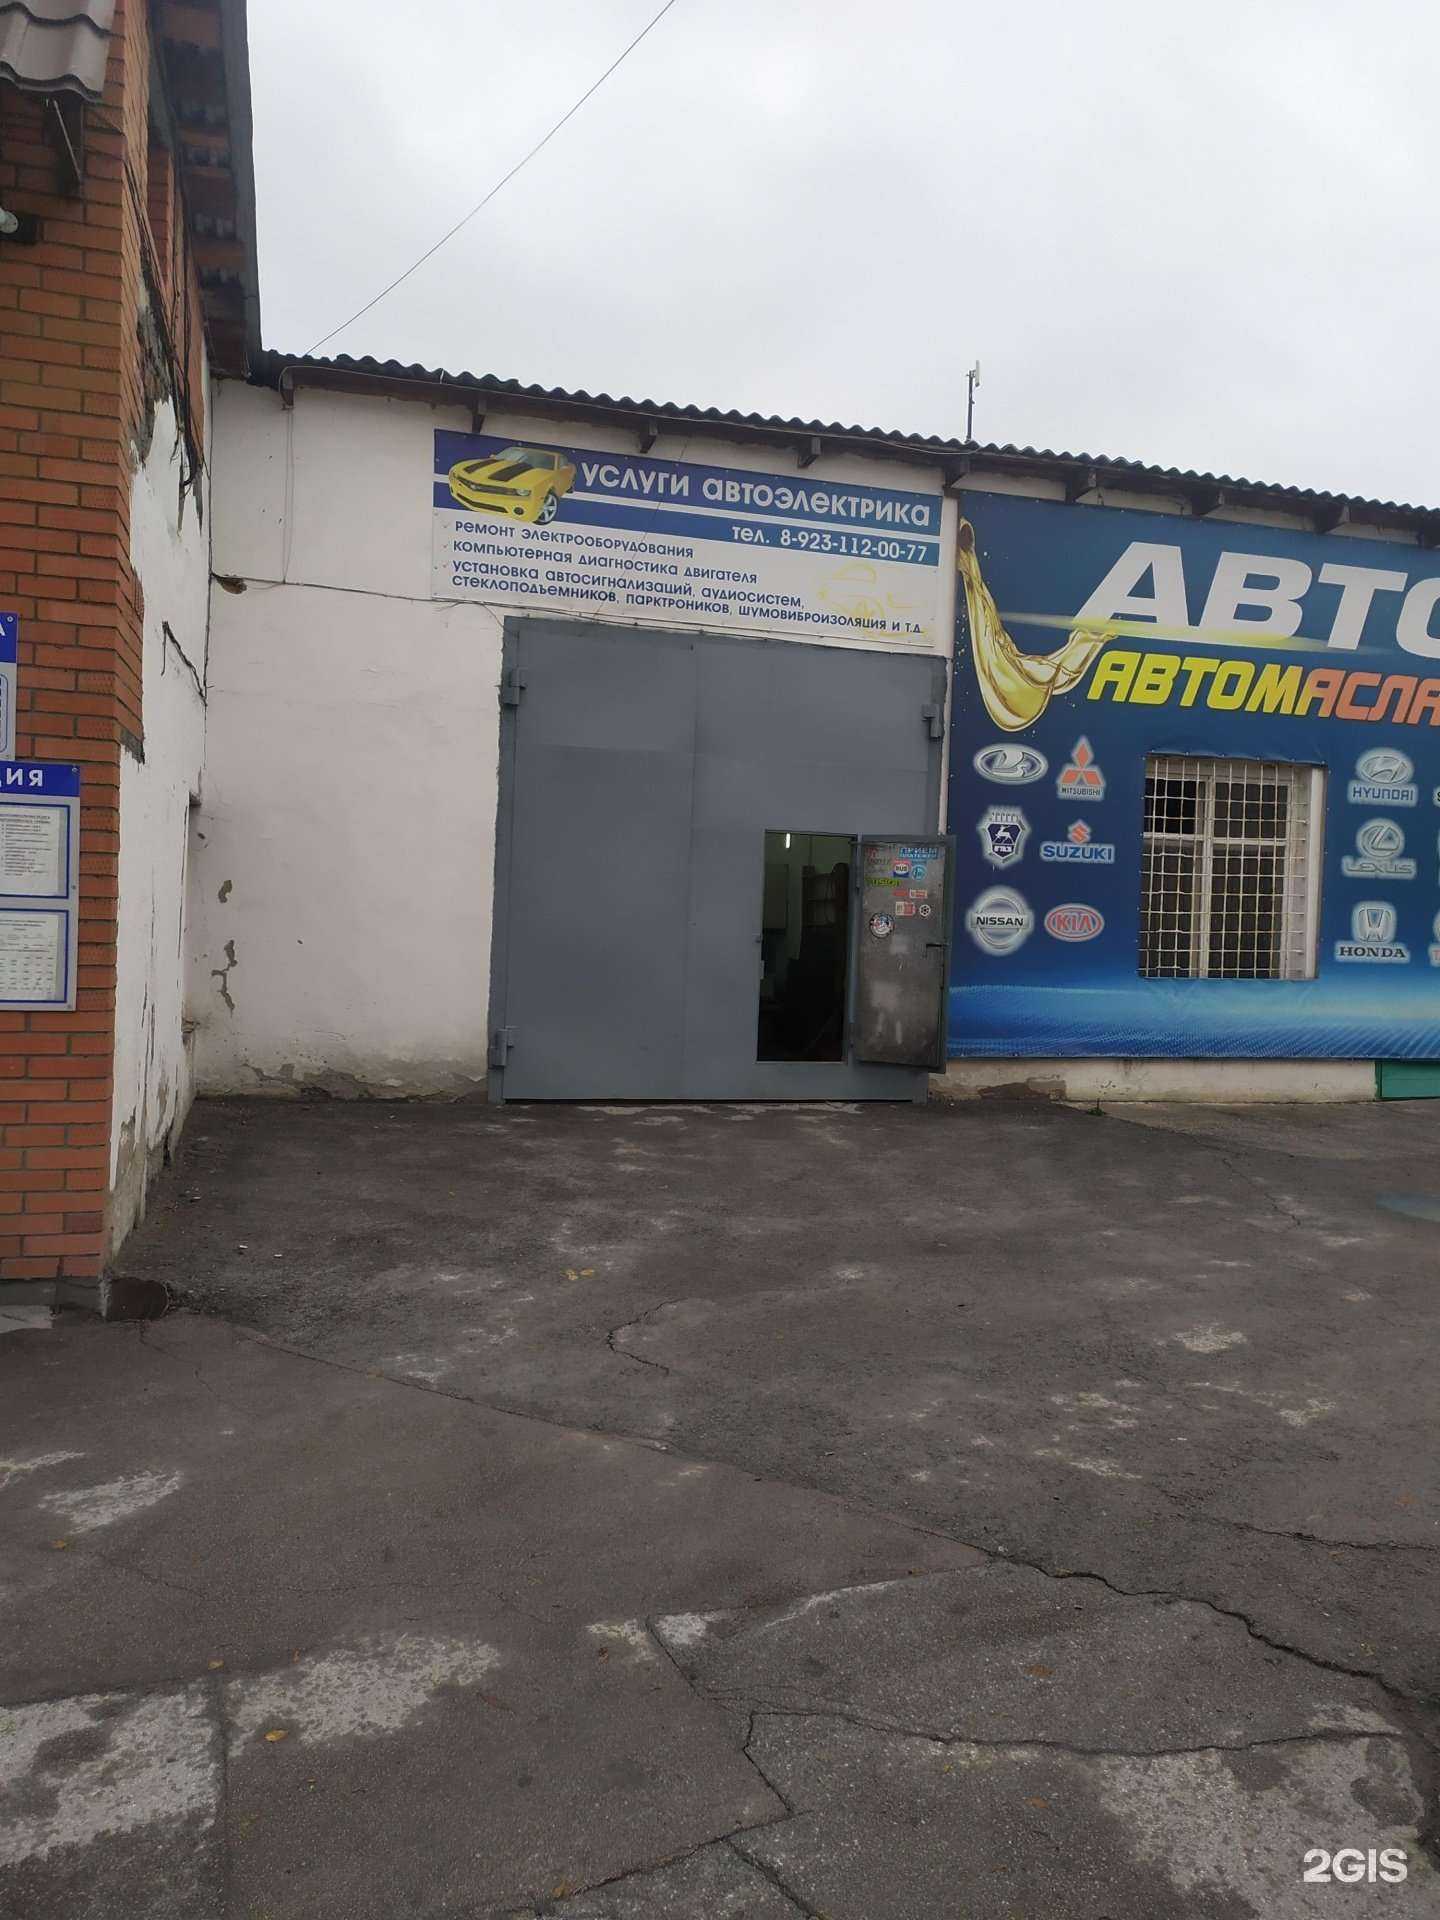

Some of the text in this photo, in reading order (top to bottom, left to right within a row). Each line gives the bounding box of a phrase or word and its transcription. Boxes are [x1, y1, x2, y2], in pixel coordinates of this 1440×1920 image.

[581, 462, 930, 527] услуги автоэлектрика
[455, 520, 694, 558] ремонт электрооборудования
[732, 525, 928, 562] тел. 8-923-112-00-77
[452, 560, 539, 580] установка
[453, 540, 757, 584] компьютерная диагностика двигателя
[738, 605, 886, 631] шумовиброизоляция
[892, 621, 900, 632] и
[0, 767, 43, 786] ИЯ
[1061, 786, 1101, 796] MITSUBISHI
[1352, 786, 1413, 801] HYUNDAI
[1043, 845, 1112, 861] SUZUKI
[1347, 862, 1412, 874] LEXUS
[976, 916, 1024, 926] NISSAN
[1055, 913, 1092, 932] KIA
[1339, 946, 1406, 958] HONDA
